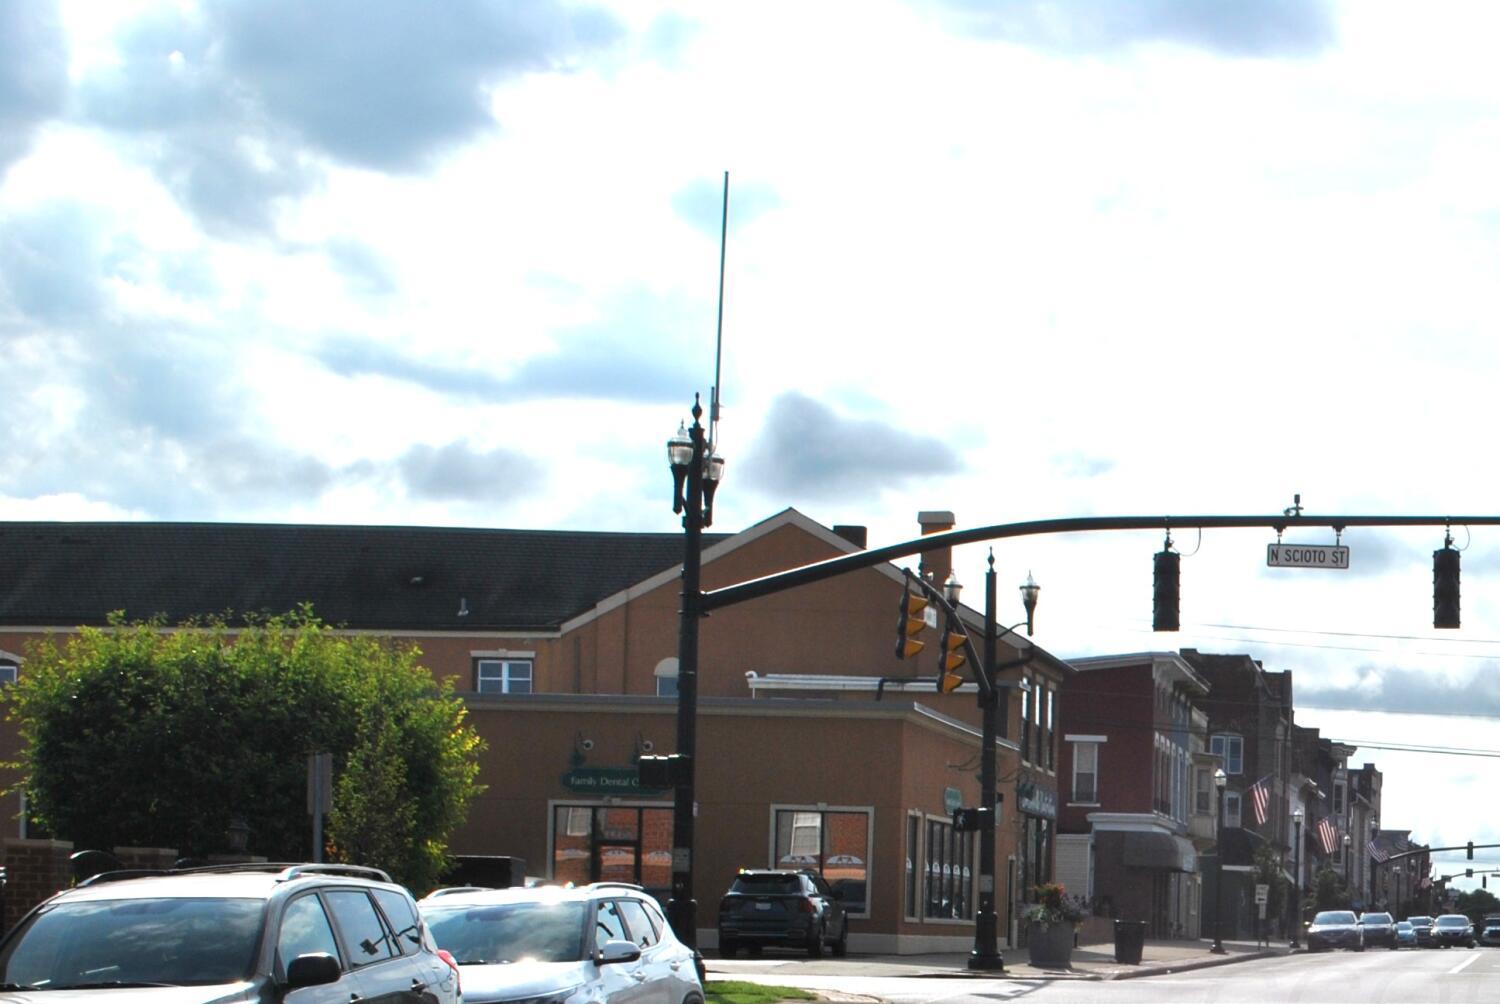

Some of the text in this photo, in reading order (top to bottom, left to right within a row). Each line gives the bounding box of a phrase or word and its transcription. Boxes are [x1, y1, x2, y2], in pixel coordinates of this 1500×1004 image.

[1271, 549, 1345, 564] N SCIOTO ST
[571, 776, 597, 787] Family
[600, 776, 629, 786] Dental
